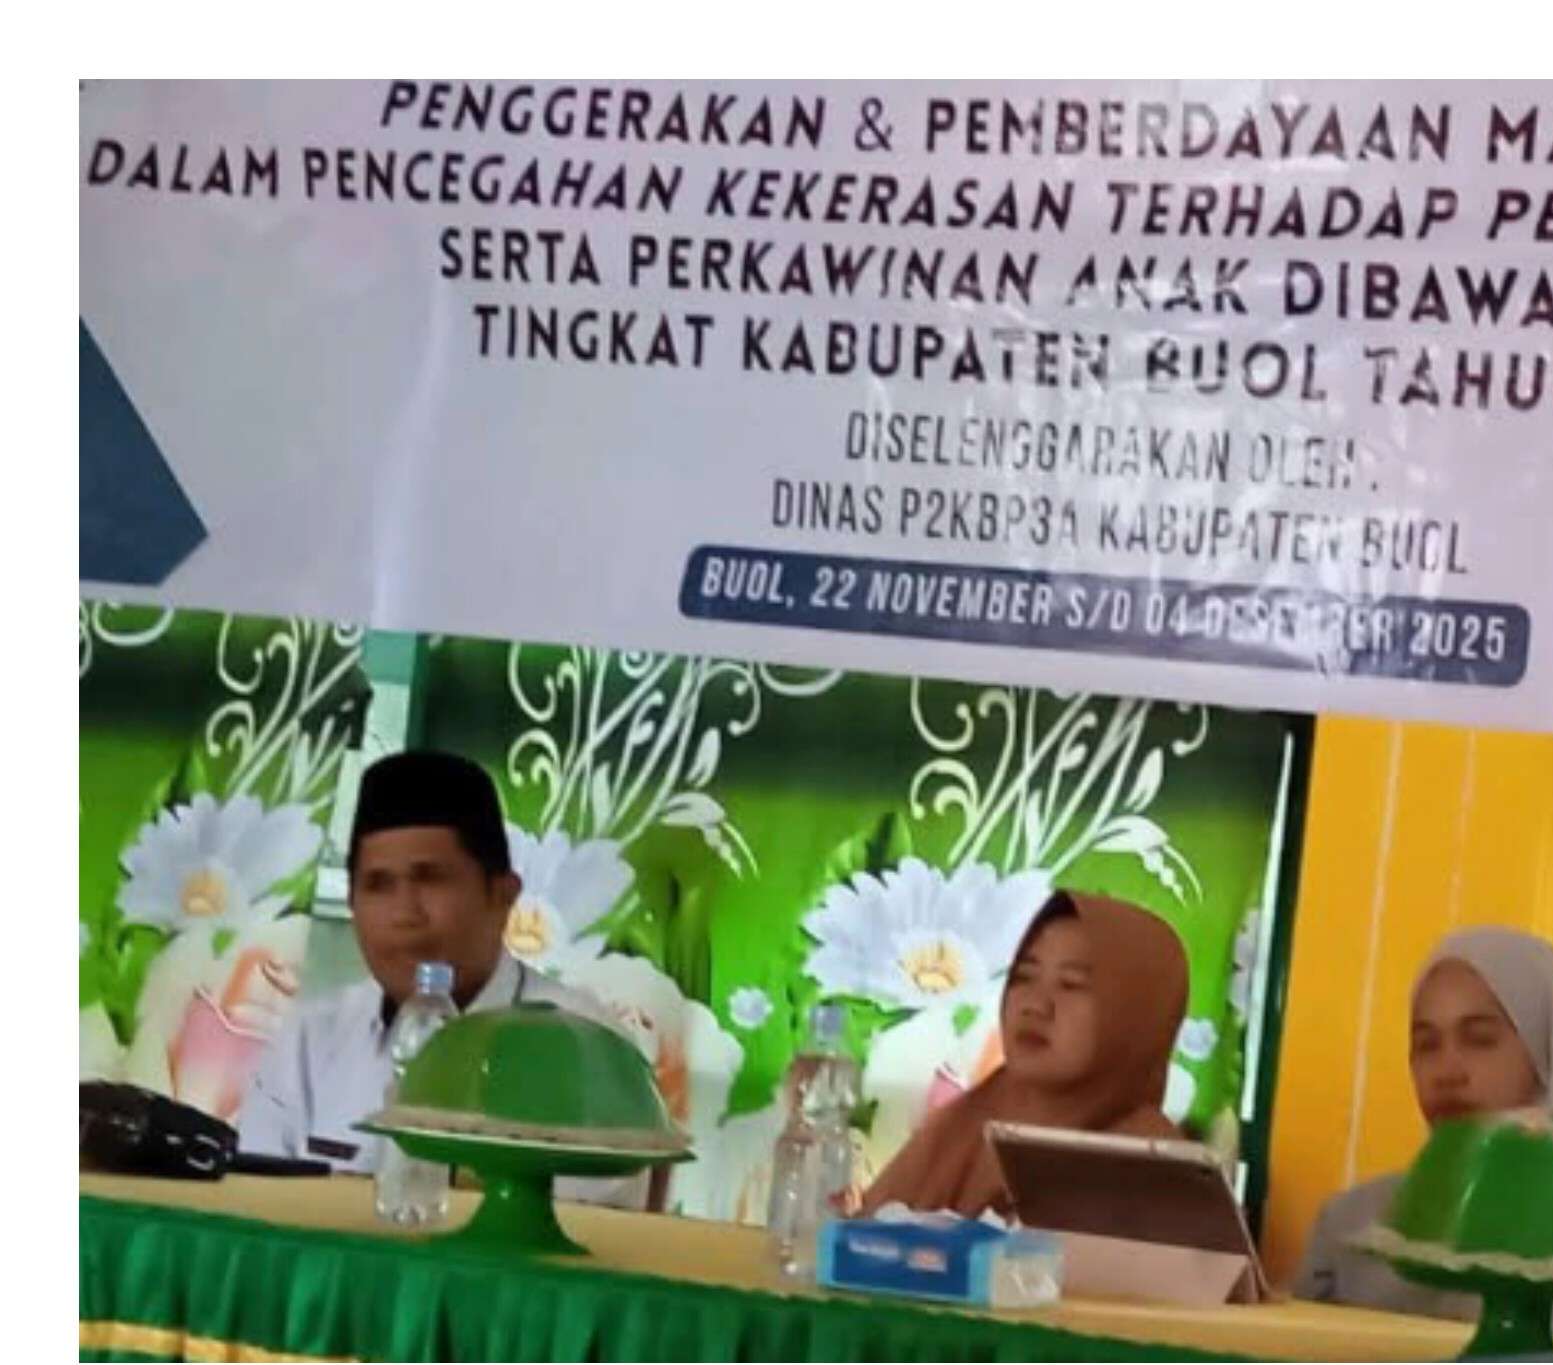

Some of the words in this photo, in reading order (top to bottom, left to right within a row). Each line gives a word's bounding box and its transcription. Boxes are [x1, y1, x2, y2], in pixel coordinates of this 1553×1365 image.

[380, 81, 826, 148] PENGGERAKAN
[854, 97, 893, 152] &
[925, 99, 1450, 163] PEMBERDAYAAN
[87, 136, 280, 198] DALAM
[304, 147, 683, 213] PENCEGAHAN
[706, 167, 1075, 232] KEKERASAN
[1106, 182, 1459, 241] TERHADAP
[439, 226, 601, 285] SERTA
[629, 234, 1039, 304] PERKAWINAN
[1065, 254, 1249, 315] ANAK
[473, 304, 714, 368] TINGKAT
[743, 316, 1109, 389] KABUPATEN
[1146, 337, 1326, 401] BUOL
[845, 411, 1230, 483] DISELENGGARAKAN
[772, 477, 884, 535] DINAS
[899, 487, 1078, 547] P2KBP3A
[701, 556, 794, 608] BUOL,
[810, 566, 857, 609] 22
[866, 571, 1053, 627] NOVEMBER
[1066, 585, 1131, 632] S/D
[1145, 591, 1190, 637] 04
[1410, 610, 1506, 661] 2025
